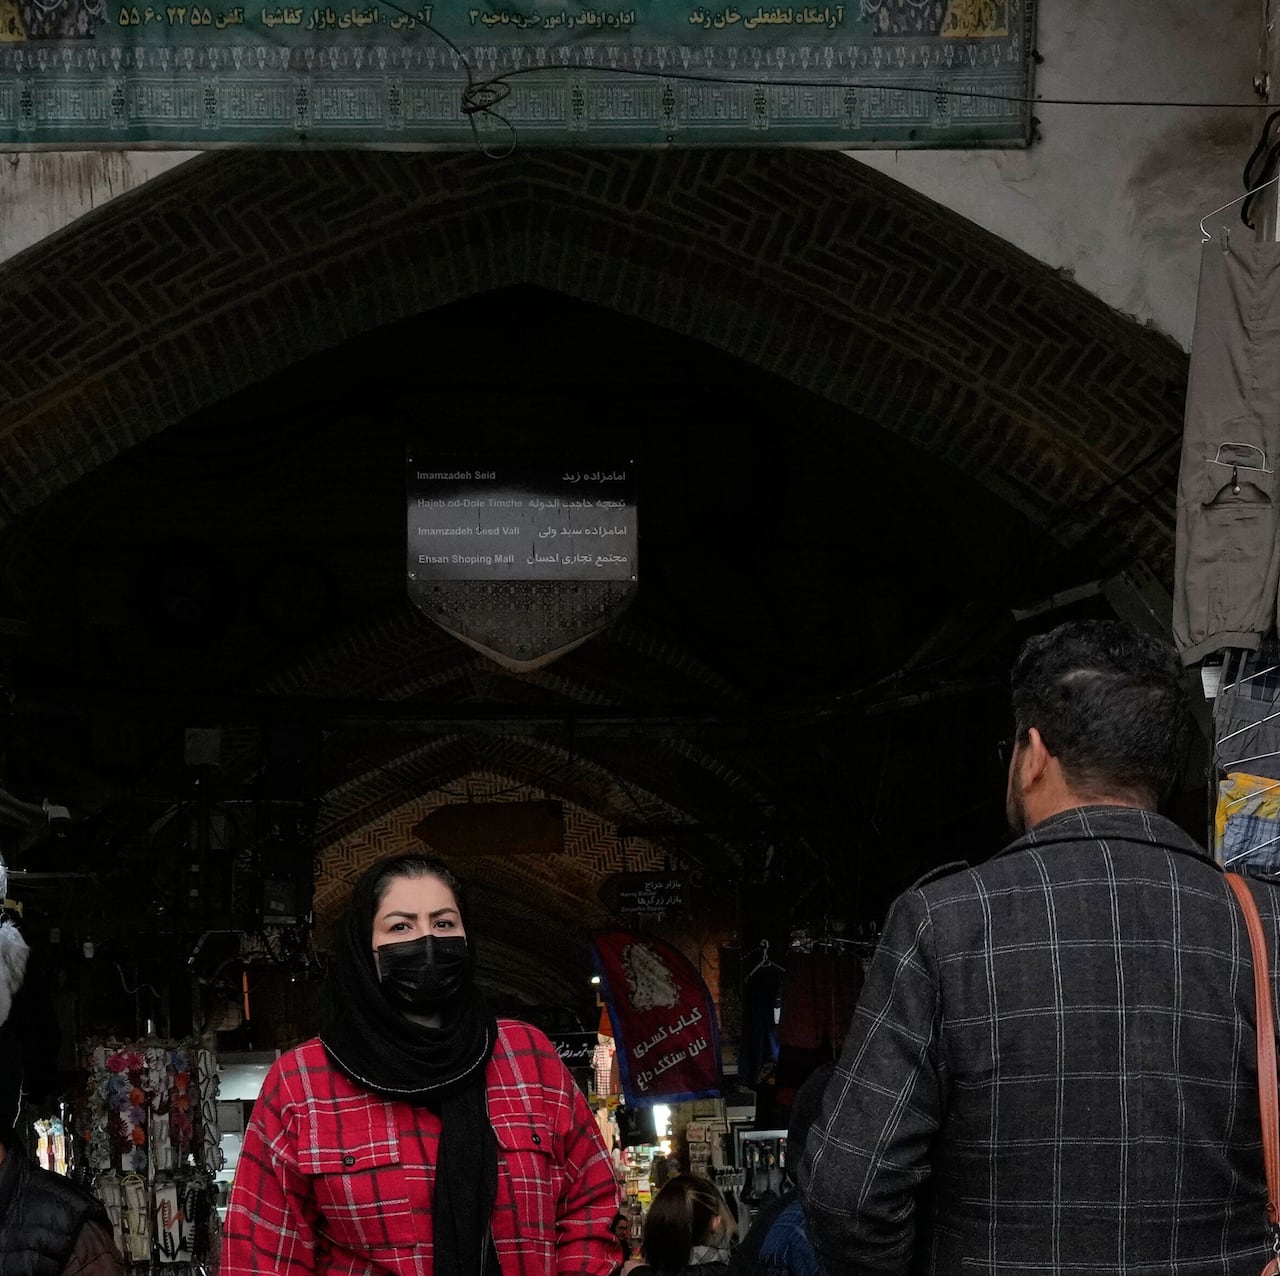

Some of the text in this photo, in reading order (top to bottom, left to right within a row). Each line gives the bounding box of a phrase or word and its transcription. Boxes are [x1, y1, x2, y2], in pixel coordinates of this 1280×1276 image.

[215, 7, 245, 29] تلفن
[306, 7, 336, 30] بازار
[338, 7, 379, 29] انتهای
[480, 8, 510, 29] ناحیه
[543, 9, 566, 29] امور
[575, 8, 606, 28] اوقاف
[608, 10, 636, 28] اداره
[688, 5, 845, 29] آرامگاه لطفعلی خان زند
[417, 471, 472, 480] Imamzadeh
[584, 471, 626, 484] امامزاده
[417, 498, 445, 509] Hajeb
[418, 527, 473, 536] Imamzadeh
[502, 526, 520, 536] Vali
[538, 525, 557, 539] ولی
[584, 525, 627, 538] امامزاده
[418, 554, 515, 566] Ehsan Shoping Mall
[526, 553, 628, 567] مجتمع تجاری احسان
[632, 1007, 703, 1060] کباب کسری
[688, 1036, 708, 1057] نان
[636, 1070, 654, 1092] داغ
